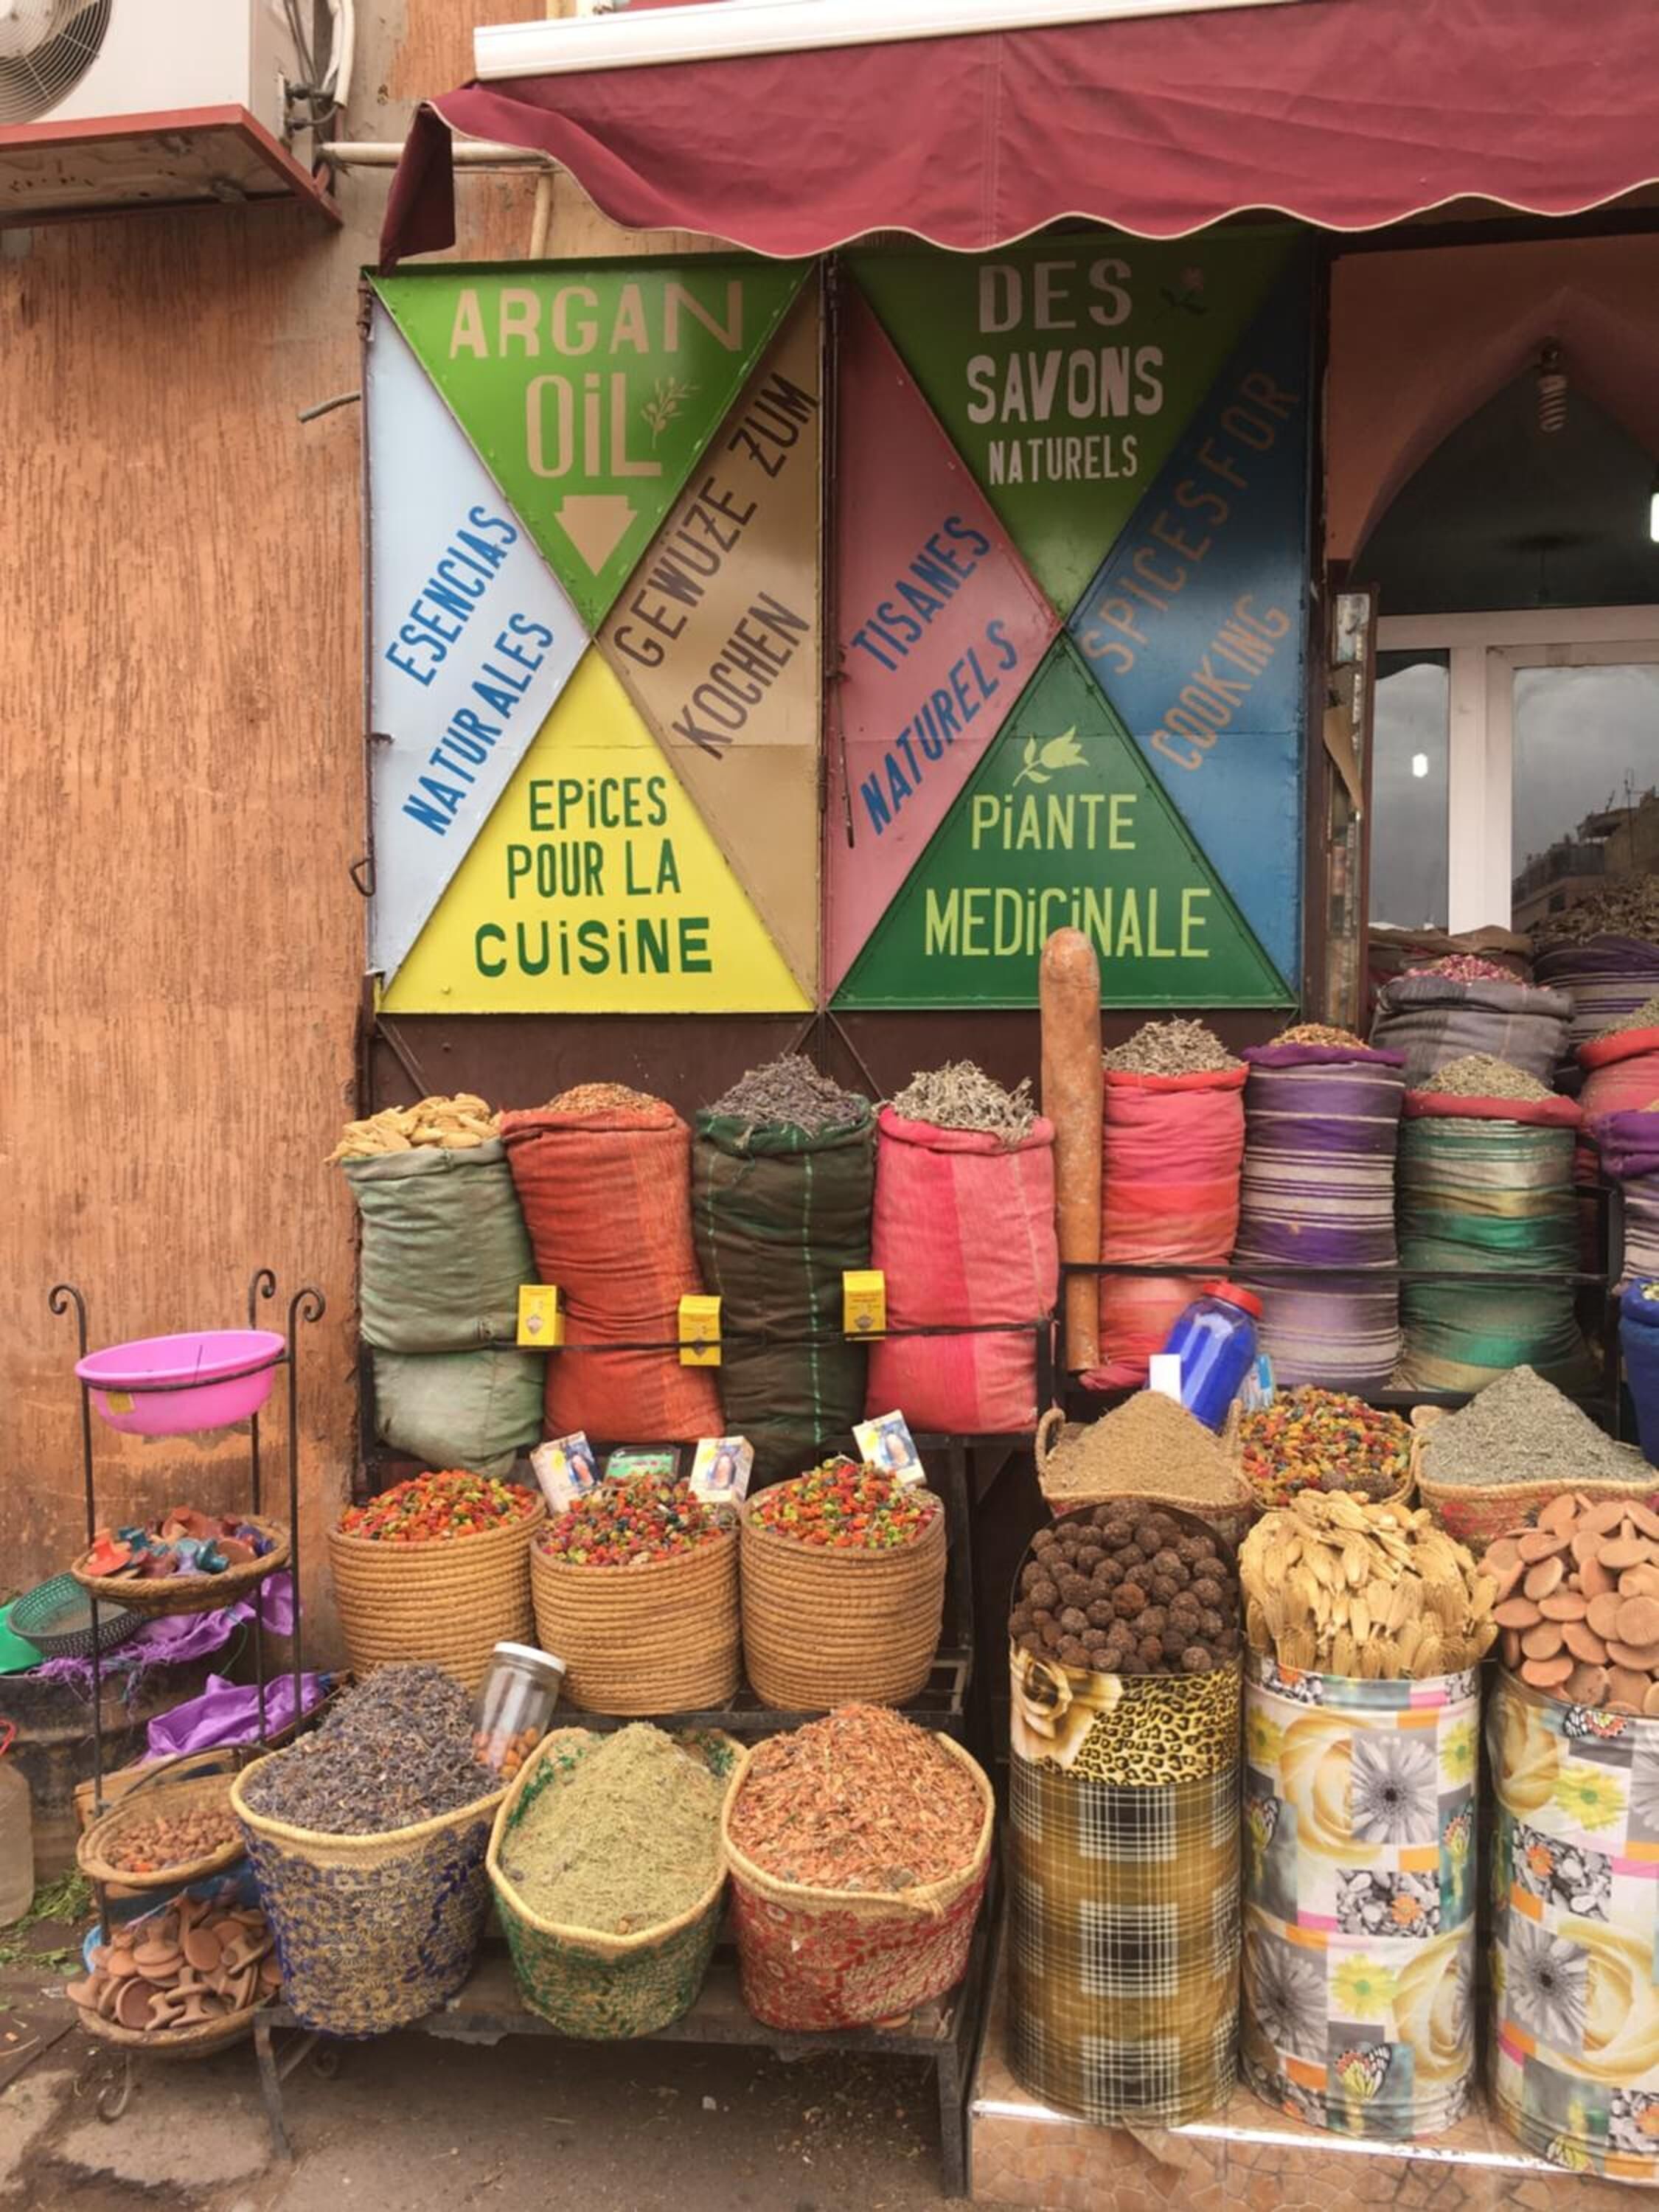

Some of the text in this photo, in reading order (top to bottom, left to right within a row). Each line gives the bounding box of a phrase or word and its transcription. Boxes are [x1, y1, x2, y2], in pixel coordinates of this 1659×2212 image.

[449, 281, 743, 359] ARGAN
[978, 258, 1133, 333] DES
[728, 373, 820, 478] ZUM
[967, 345, 1164, 424] SAVONS
[988, 434, 1138, 485] NATURELS
[385, 506, 518, 687] ESENCIAS
[850, 516, 990, 672] TISANES
[1082, 372, 1300, 674] SPICES FOR
[402, 613, 554, 837] NATURALES
[672, 592, 810, 761] KOCHEN
[860, 619, 1018, 835] NATURELS
[1150, 594, 1290, 772] COOKING
[507, 838, 681, 900] POUR LA
